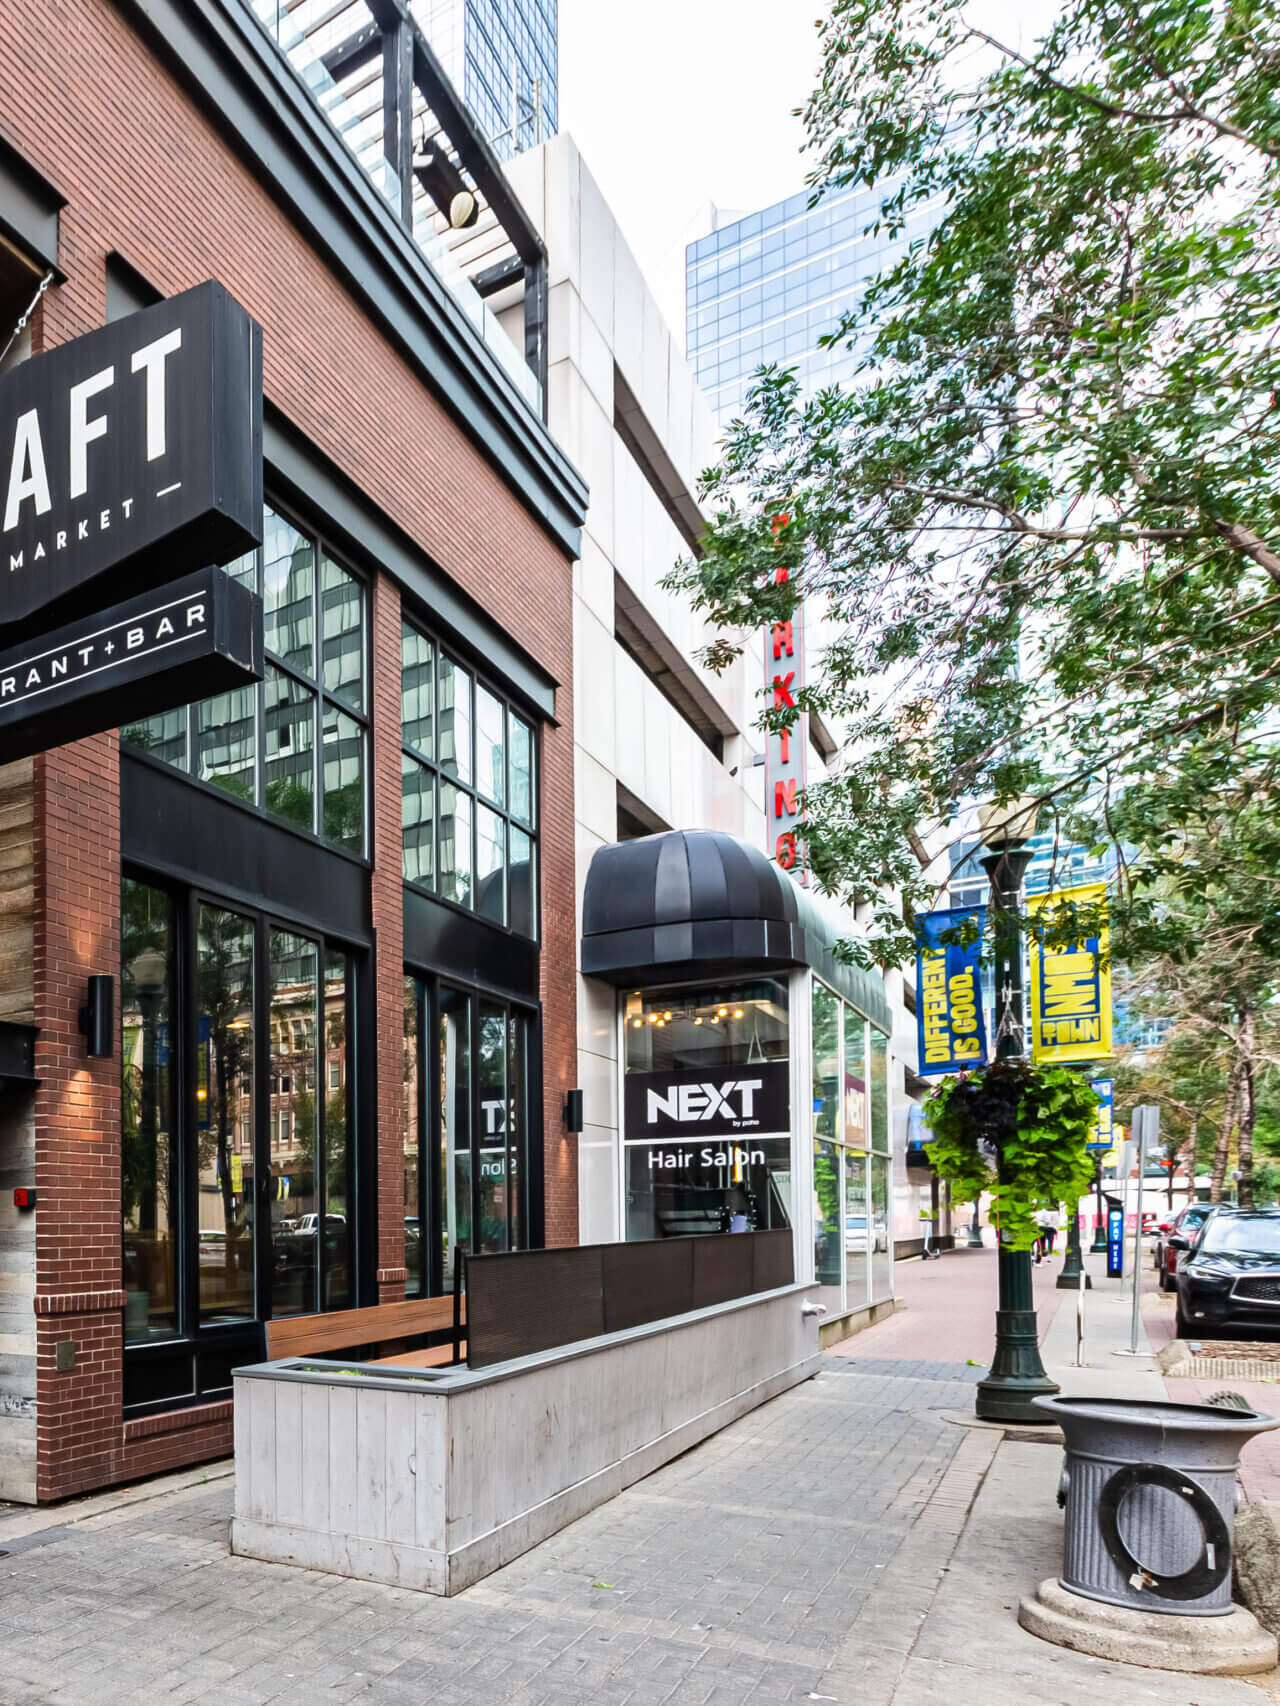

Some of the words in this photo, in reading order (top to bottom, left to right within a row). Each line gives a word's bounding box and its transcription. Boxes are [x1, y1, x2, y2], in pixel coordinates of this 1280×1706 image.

[9, 499, 134, 570] MARKET
[921, 948, 951, 1064] DIFFERENT
[949, 966, 977, 1034] GOOD.
[953, 1037, 981, 1060] IS
[647, 1079, 763, 1124] NEXT
[648, 1149, 693, 1168] Hair
[700, 1146, 765, 1167] Salon
